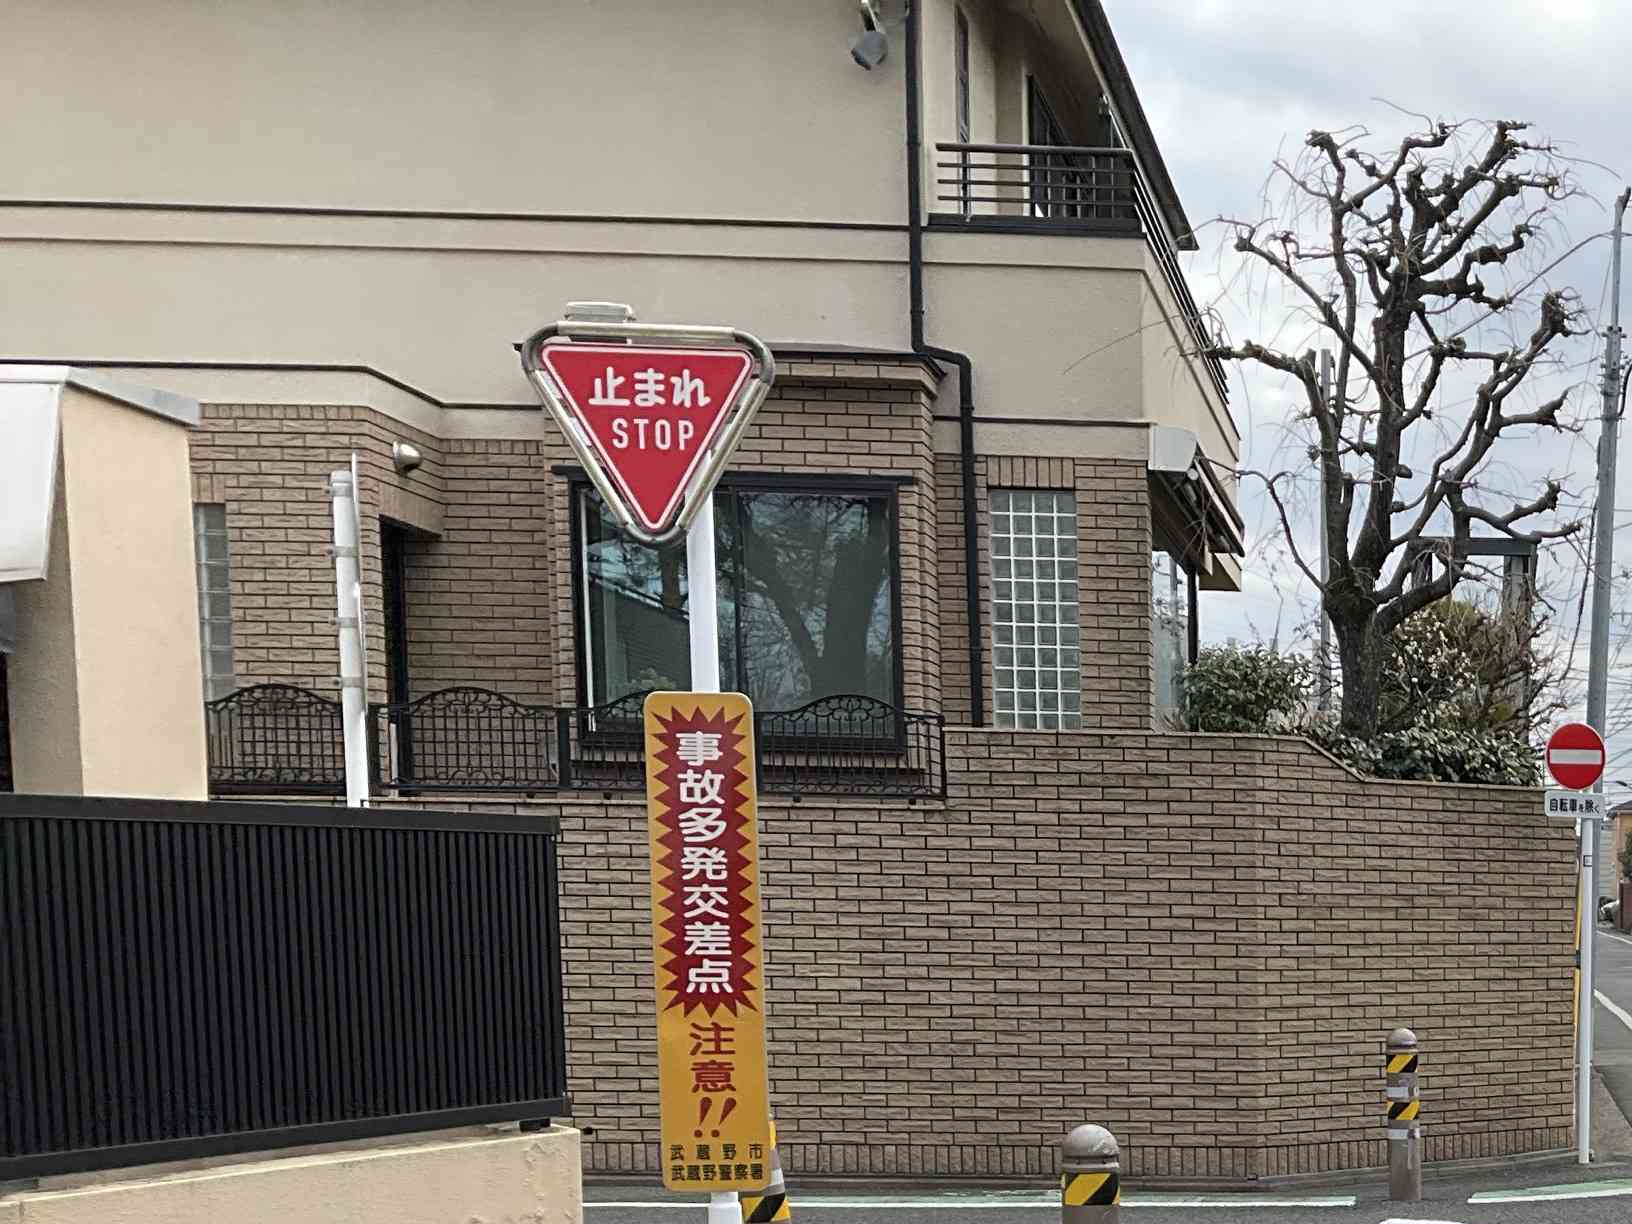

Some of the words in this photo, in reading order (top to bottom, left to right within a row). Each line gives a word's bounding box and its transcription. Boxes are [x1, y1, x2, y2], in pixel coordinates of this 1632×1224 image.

[588, 366, 711, 409] 止まれ
[611, 418, 694, 450] STOP
[675, 730, 733, 994] 事故多発交差点
[670, 1143, 763, 1161] 武蔵野市
[671, 1163, 763, 1181] 武蔵野警察署
